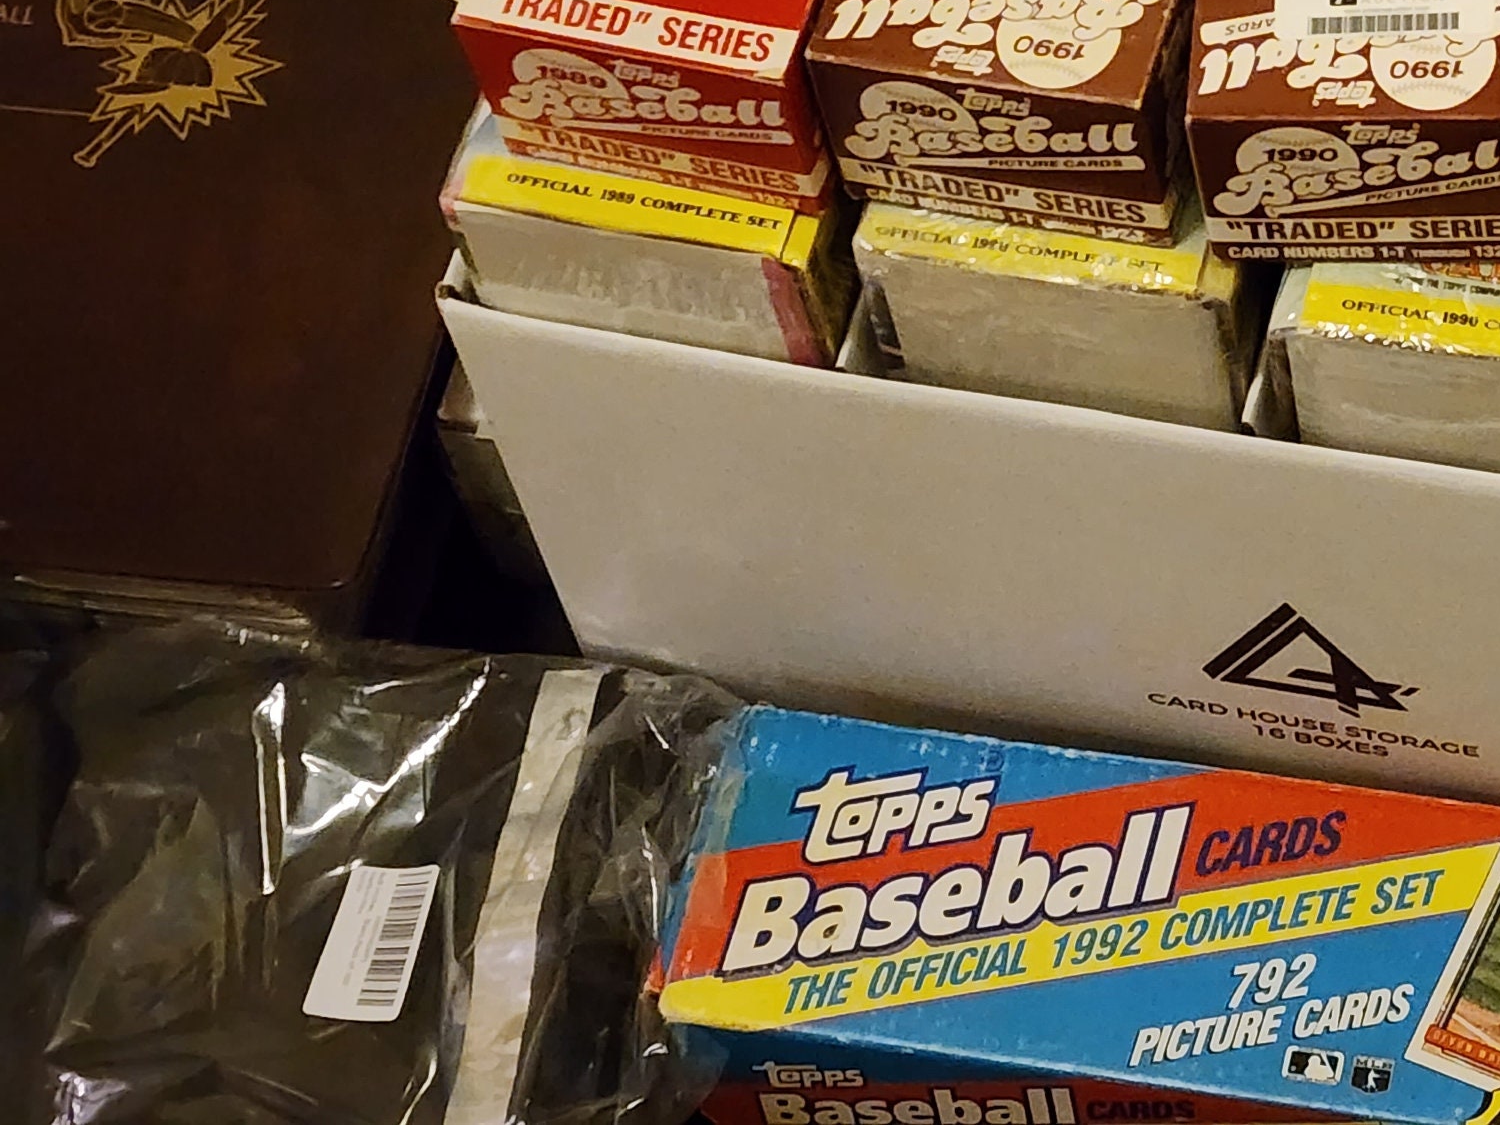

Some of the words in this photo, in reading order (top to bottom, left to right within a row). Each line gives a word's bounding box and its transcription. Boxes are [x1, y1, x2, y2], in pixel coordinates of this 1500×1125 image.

[658, 16, 775, 63] SERIES
[1013, 35, 1086, 61] 1990
[1389, 60, 1464, 80] 1990
[499, 79, 786, 126] Baseball
[885, 99, 958, 122] 1990
[844, 116, 1138, 160] Baseball
[1263, 147, 1338, 162] 1990
[689, 155, 801, 192] SERIES
[988, 158, 1060, 168] PICTURE
[1063, 158, 1124, 168] CARDS
[506, 171, 594, 199] OFFICIAL
[639, 196, 743, 225] COMPLETE
[745, 214, 783, 233] SET
[1033, 191, 1146, 223] SERIES
[1366, 185, 1440, 202] PICTURE
[1226, 220, 1395, 241] "TRADED"
[1228, 245, 1279, 260] CARD
[1283, 246, 1375, 259] NUMBERS
[1148, 692, 1228, 715] CARD
[1237, 706, 1338, 734] HOUSE
[1345, 725, 1480, 758] STORAGE
[1252, 723, 1286, 740] 16
[1294, 730, 1389, 758] BOXES
[721, 805, 1193, 974] Baseball
[1196, 811, 1349, 877] CARDS
[783, 972, 854, 1015] THE
[865, 943, 1029, 1001] OFFICIAL
[1050, 920, 1149, 970] 1992
[1158, 894, 1368, 952] COMPLETE
[1371, 868, 1447, 916] SET
[1229, 952, 1319, 1011] 792
[1128, 1005, 1281, 1069] PICTURE
[1284, 983, 1415, 1055] CARDS
[756, 1087, 1079, 1125] Baseball
